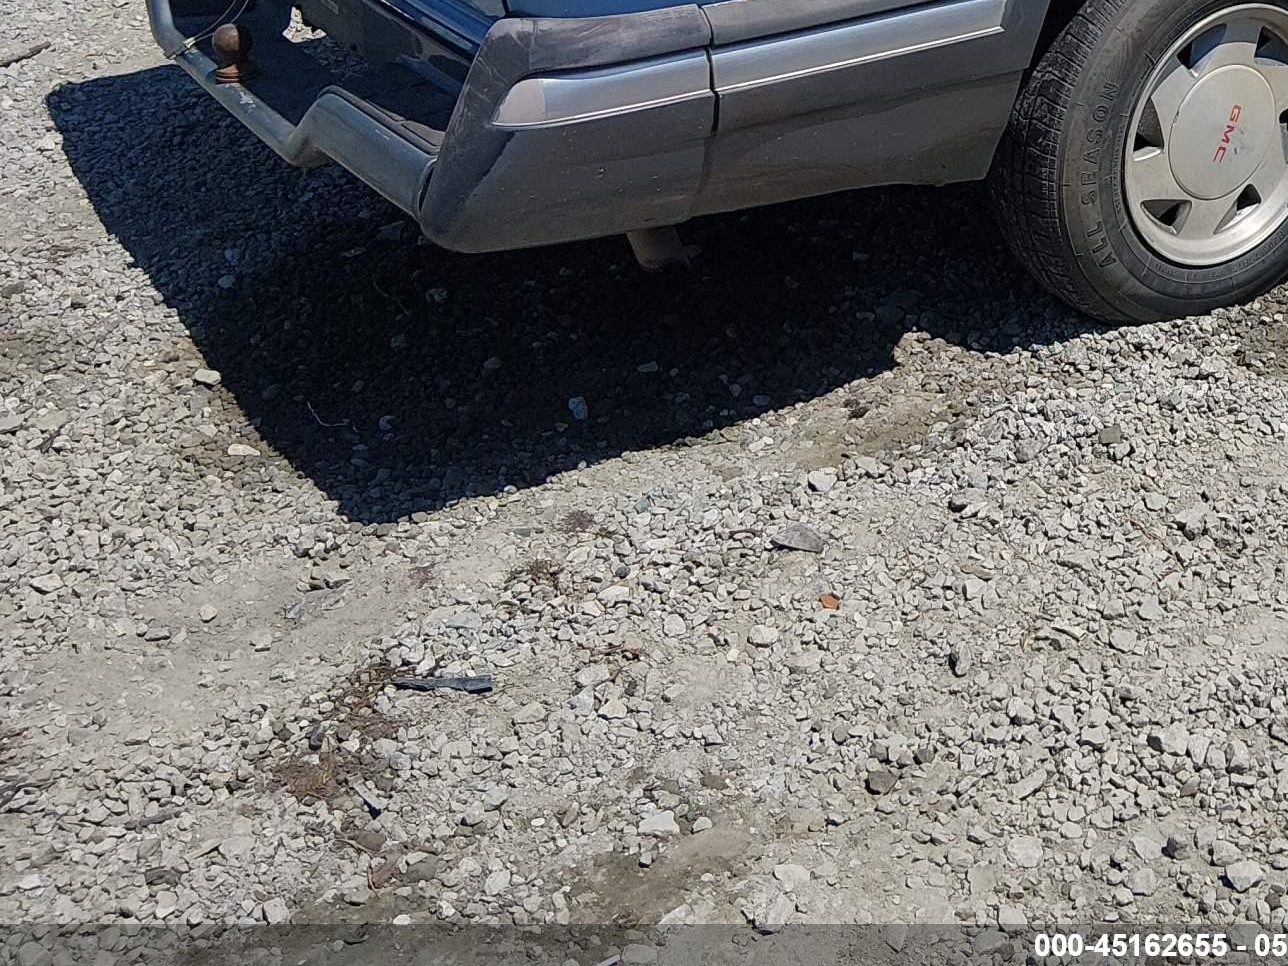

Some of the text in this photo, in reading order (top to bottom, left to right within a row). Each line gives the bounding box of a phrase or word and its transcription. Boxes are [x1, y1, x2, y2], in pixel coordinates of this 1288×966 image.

[1079, 81, 1121, 269] ALL SEASON
[1212, 104, 1243, 164] GMC
